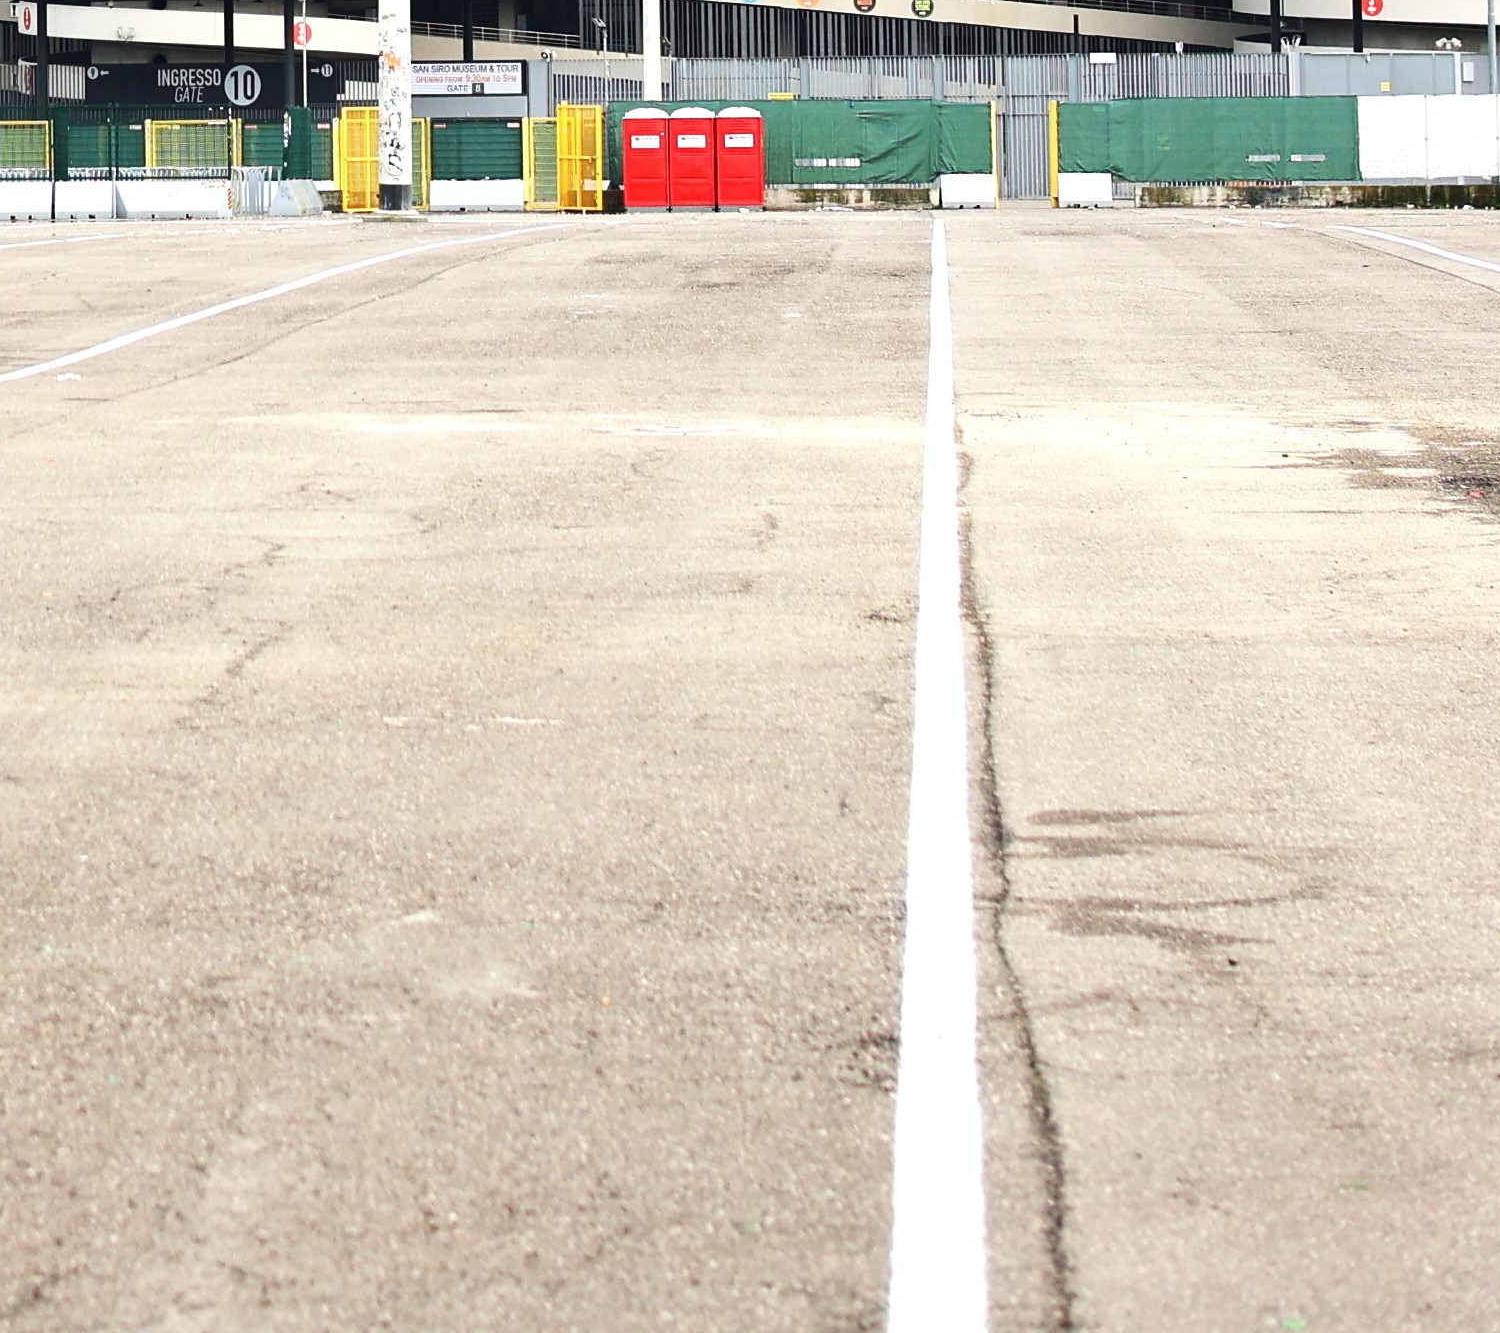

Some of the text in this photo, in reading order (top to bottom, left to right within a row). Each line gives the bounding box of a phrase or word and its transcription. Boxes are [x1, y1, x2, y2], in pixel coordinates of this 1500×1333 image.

[157, 68, 221, 86] INGRESSO
[412, 64, 429, 73] SAN
[431, 64, 450, 73] SIRO
[452, 64, 487, 73] MUSEUM
[496, 64, 519, 73] TOUR
[175, 86, 204, 103] GATE
[230, 72, 255, 101] 10
[446, 84, 469, 92] GATE
